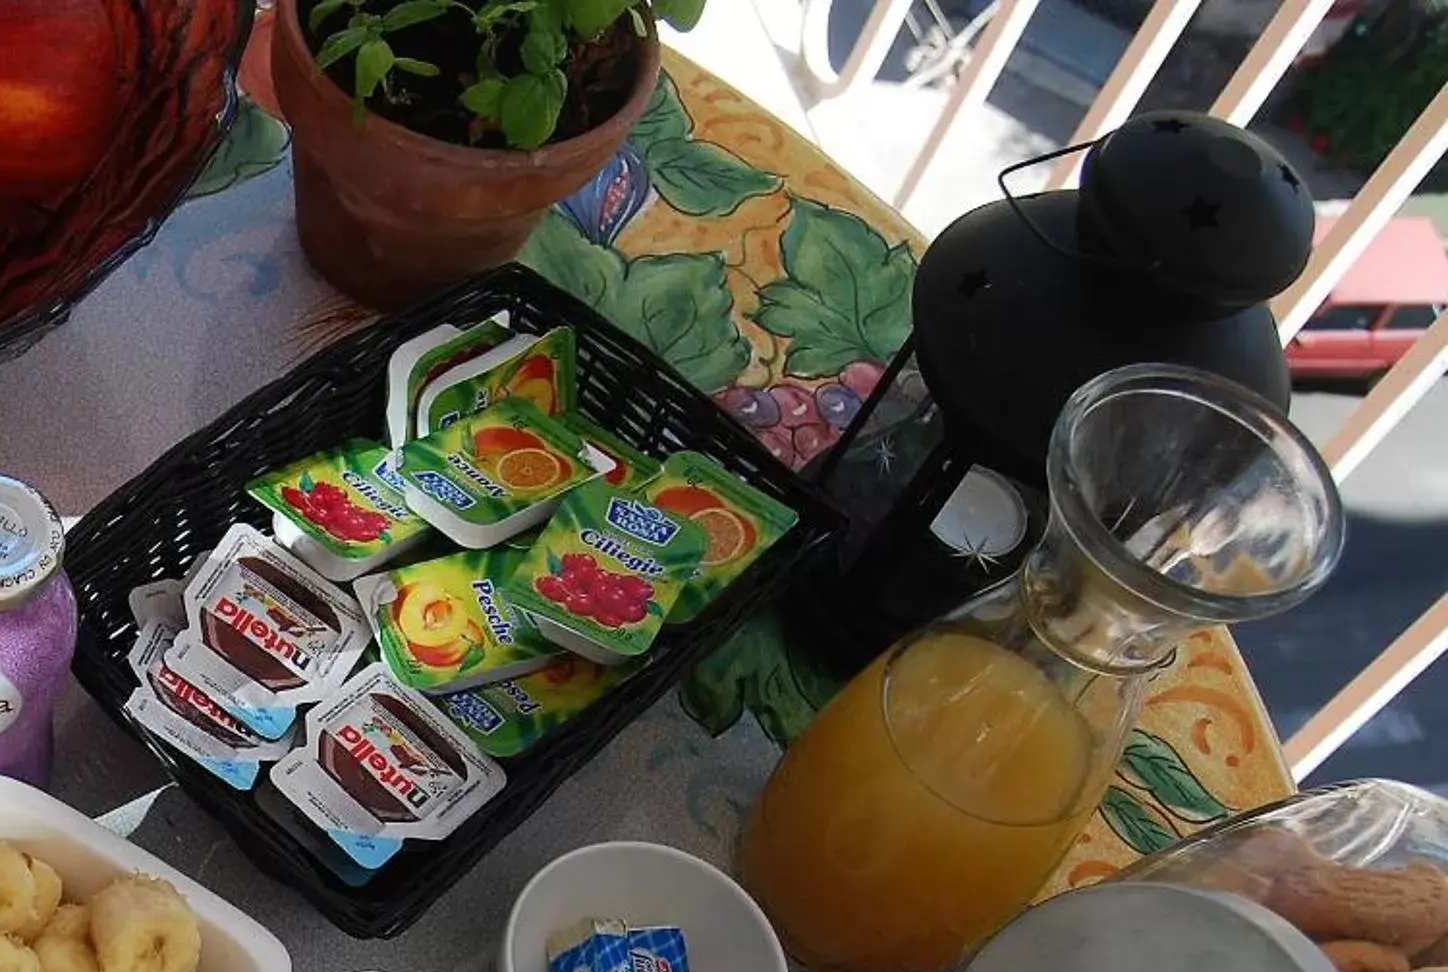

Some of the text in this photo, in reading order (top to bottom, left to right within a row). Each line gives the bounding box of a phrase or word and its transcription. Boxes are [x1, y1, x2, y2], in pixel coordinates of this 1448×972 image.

[448, 451, 509, 498] Arance
[580, 528, 665, 574] Ciliegie
[214, 596, 311, 671] nutella
[471, 580, 514, 646] Pesche
[337, 723, 432, 808] nutella
